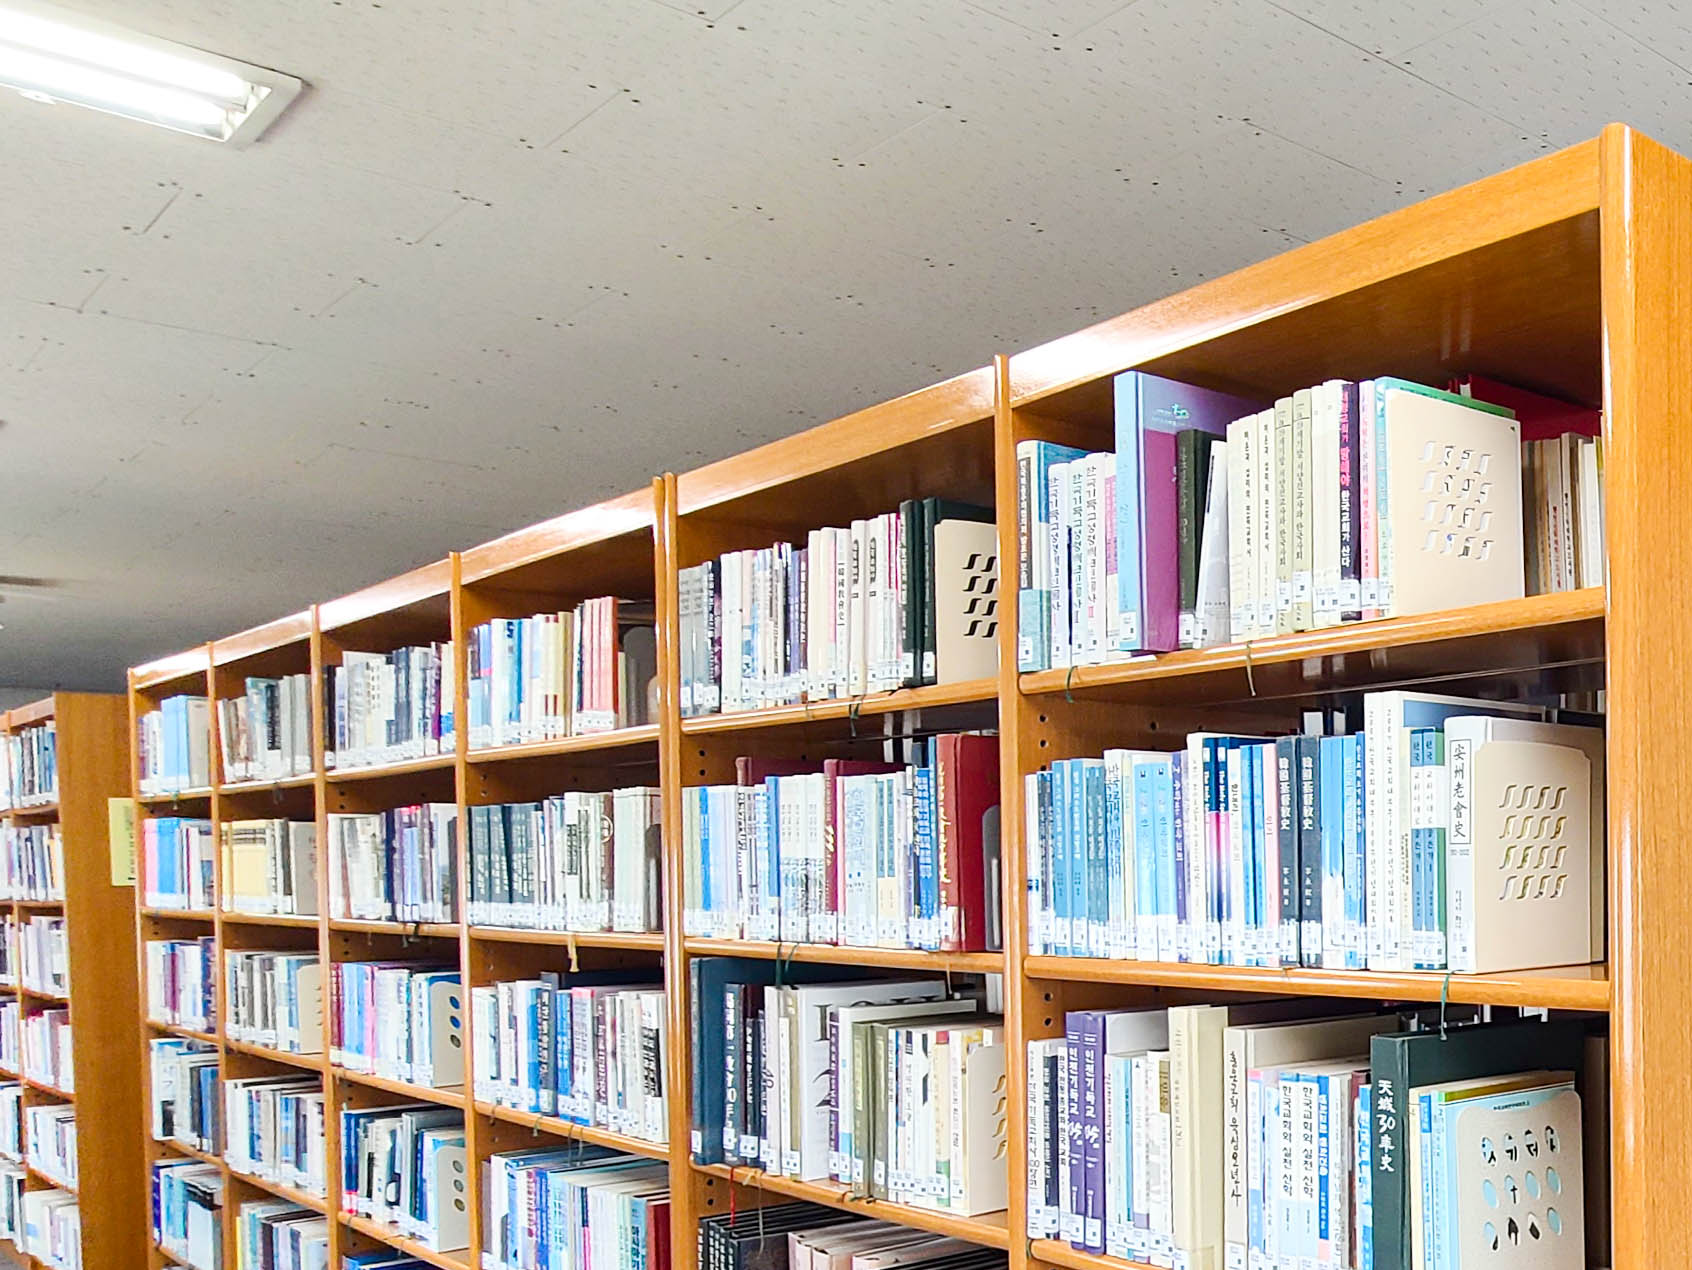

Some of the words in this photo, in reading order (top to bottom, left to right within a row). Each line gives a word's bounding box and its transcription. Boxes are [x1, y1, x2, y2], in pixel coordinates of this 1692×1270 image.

[1282, 1086, 1293, 1144] 한국교회의
[1302, 1086, 1314, 1145] 한국교회의
[1282, 1147, 1293, 1171] 실천
[1302, 1148, 1314, 1172] 실천
[1283, 1175, 1293, 1198] 신학
[1303, 1176, 1314, 1199] 신학
